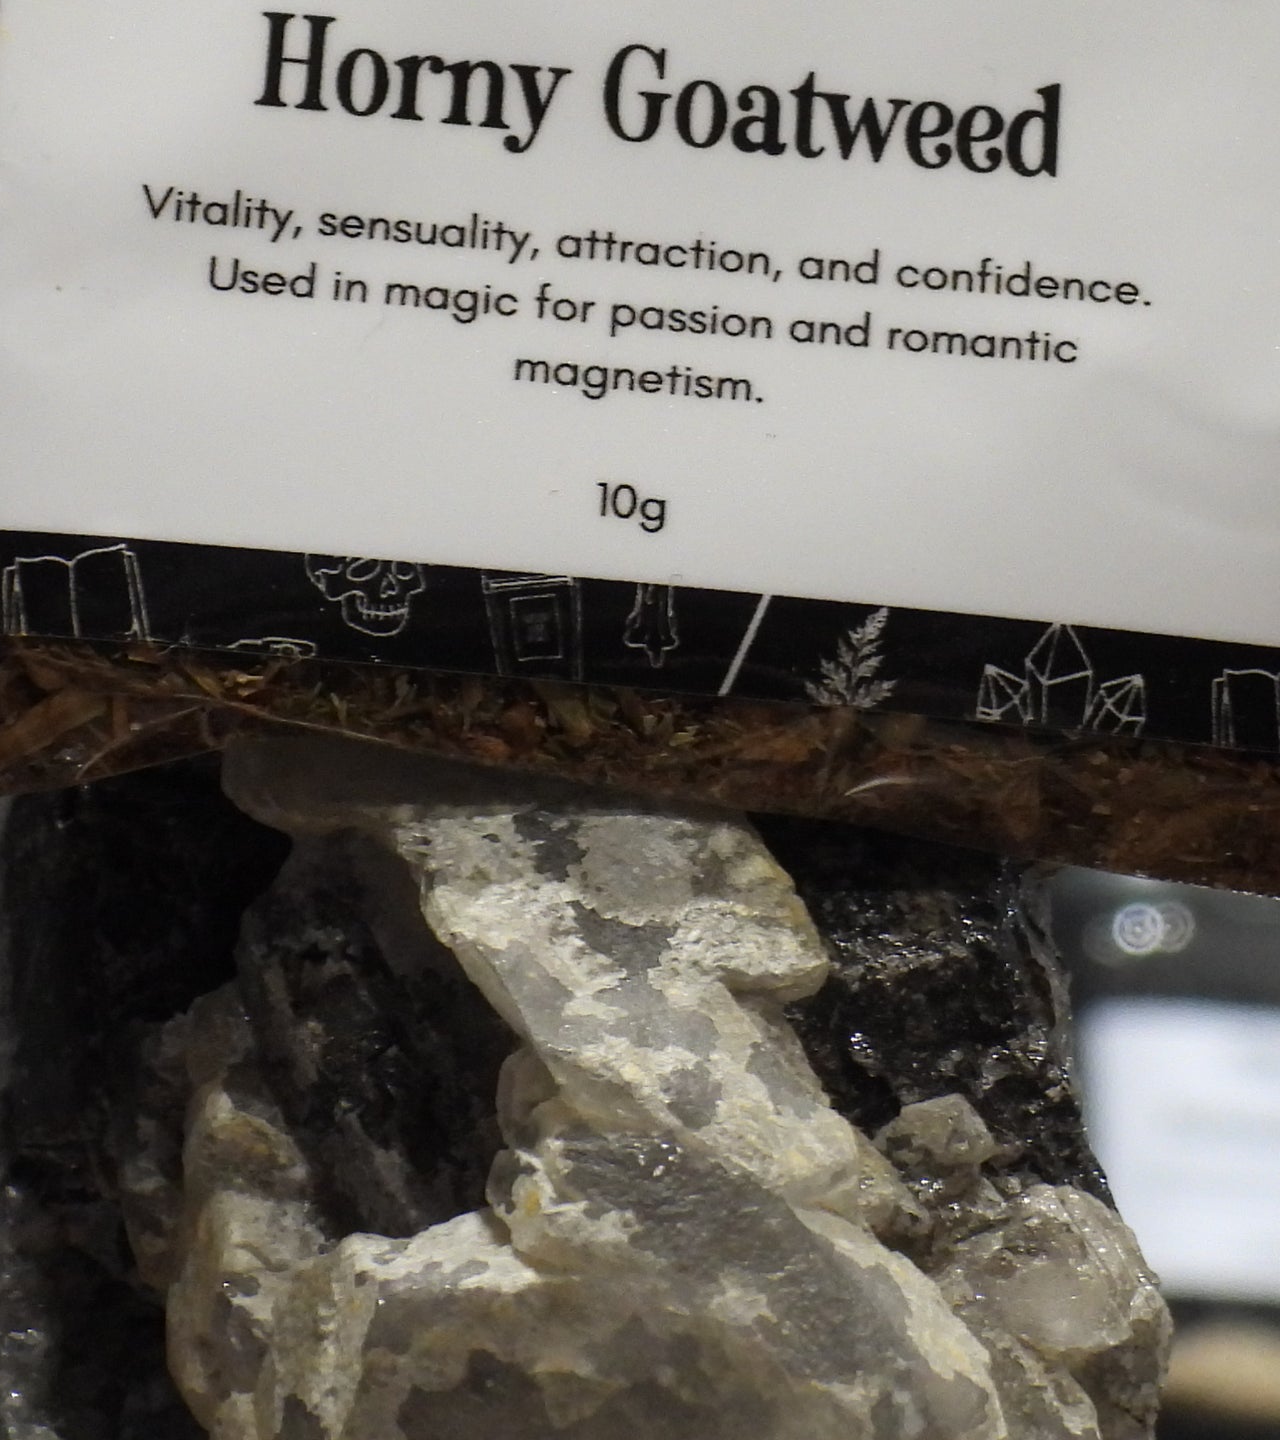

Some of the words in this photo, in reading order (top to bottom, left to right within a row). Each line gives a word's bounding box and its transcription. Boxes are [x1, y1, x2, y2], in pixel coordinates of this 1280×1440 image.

[253, 11, 574, 154] Horny
[602, 43, 1062, 178] Goatweed
[142, 184, 303, 243] Vitality,
[317, 212, 540, 265] sensuality,
[556, 229, 782, 283] attraction,
[798, 248, 880, 285] and
[895, 257, 1152, 307] confidence.
[209, 255, 317, 300] Used
[333, 271, 368, 303] in
[384, 283, 519, 326] magic
[534, 282, 596, 323] for
[610, 303, 773, 339] passion
[789, 311, 872, 349] and
[887, 328, 1078, 365] romantic
[514, 358, 764, 405] magnetism.
[596, 482, 667, 534] 10g
